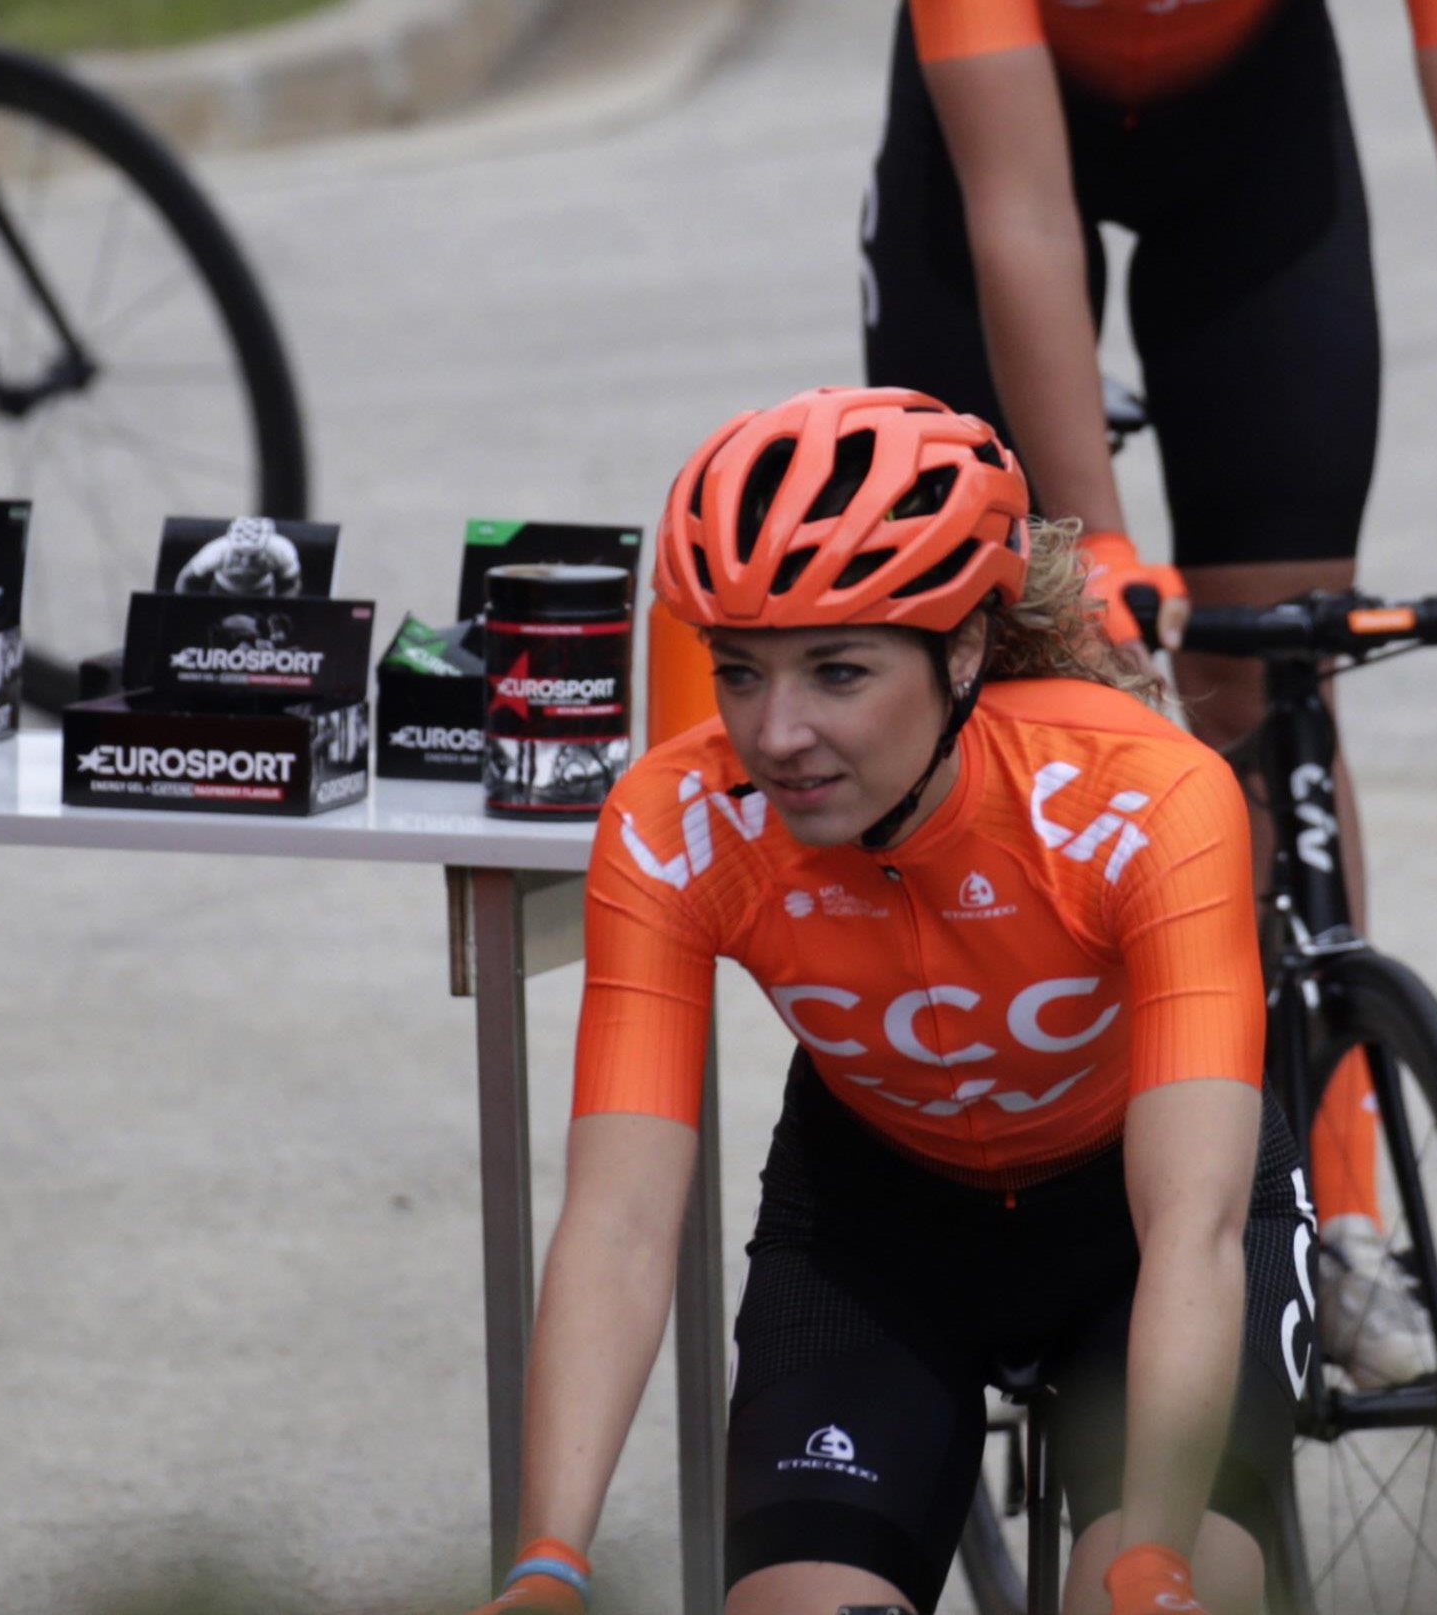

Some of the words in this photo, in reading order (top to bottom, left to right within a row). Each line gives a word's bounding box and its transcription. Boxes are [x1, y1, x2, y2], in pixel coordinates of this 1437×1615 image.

[174, 647, 324, 674] EUROSPORT
[500, 678, 616, 698] EUROSPORT
[80, 745, 296, 782] EUROSPORT
[770, 977, 1121, 1067] CCC
